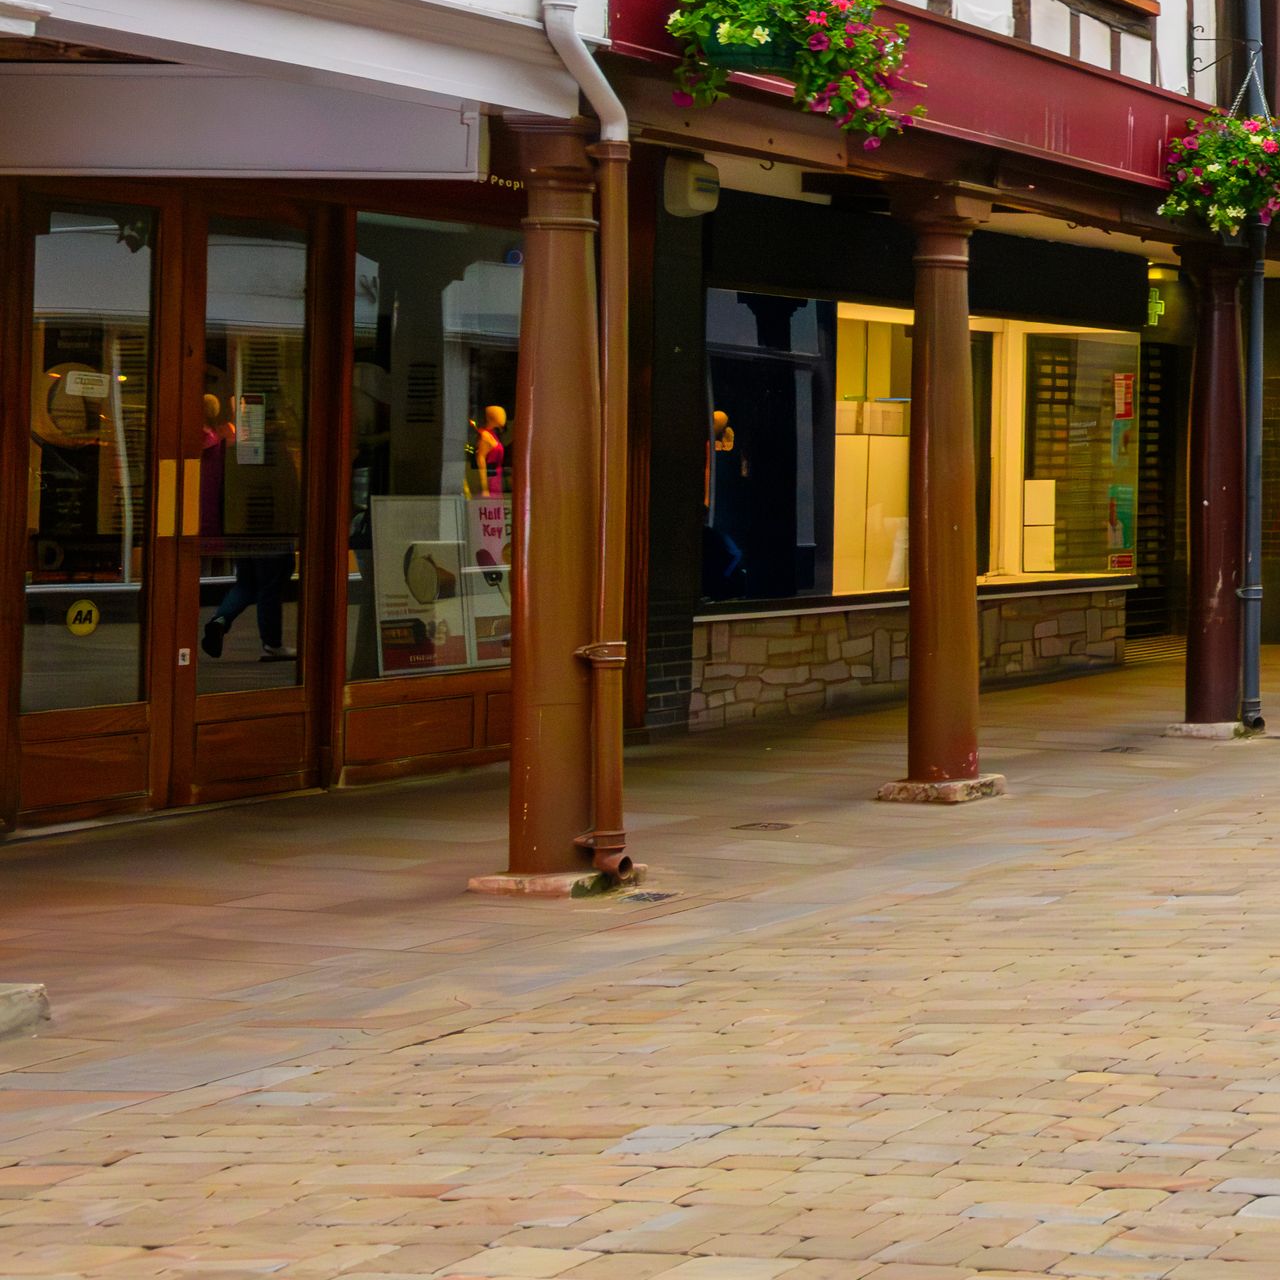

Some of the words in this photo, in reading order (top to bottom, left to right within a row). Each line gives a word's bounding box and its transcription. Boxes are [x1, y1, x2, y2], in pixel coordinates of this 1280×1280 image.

[479, 506, 501, 521] Half
[482, 523, 503, 539] Key
[72, 610, 93, 624] AA
